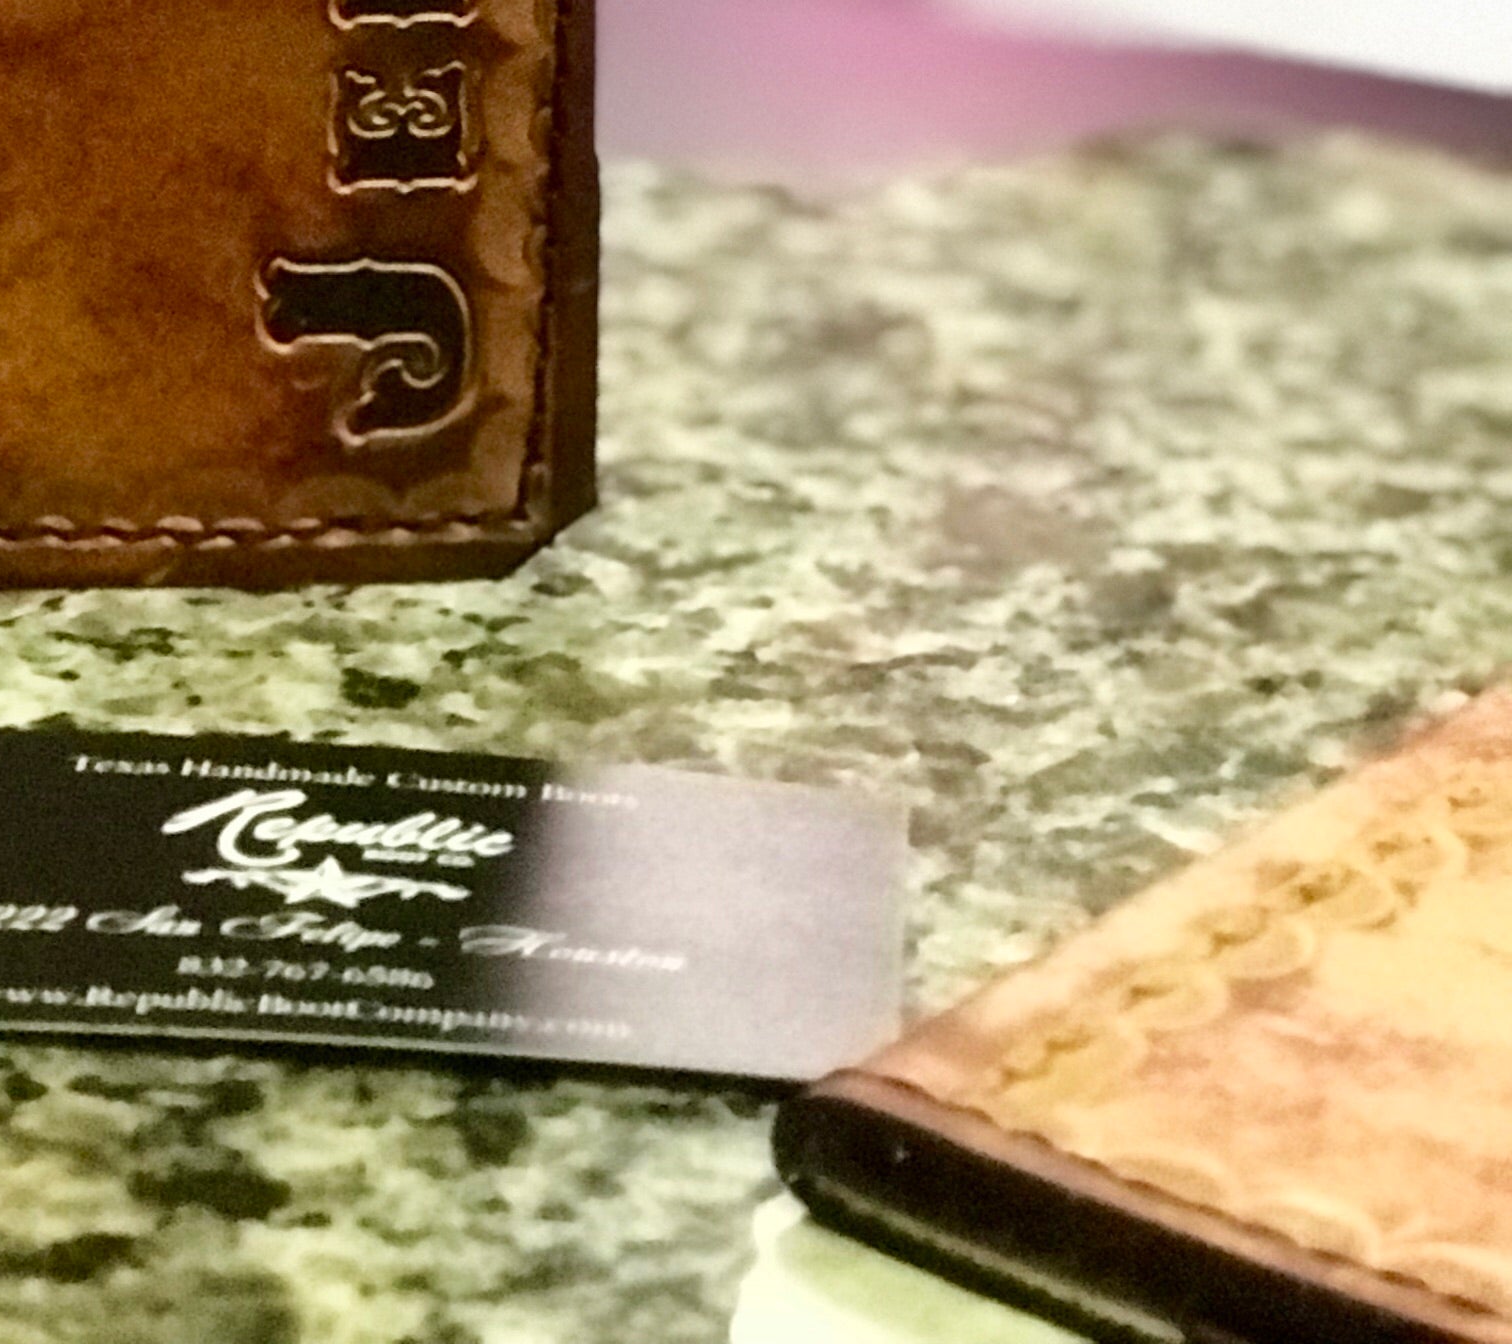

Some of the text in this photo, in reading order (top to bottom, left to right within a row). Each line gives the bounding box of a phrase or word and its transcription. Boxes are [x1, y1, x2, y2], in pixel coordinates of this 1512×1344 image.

[72, 753, 171, 776] Texas
[180, 757, 376, 787] Handmade
[387, 771, 528, 799] Custom
[159, 788, 514, 868] Republic
[85, 903, 202, 937] San
